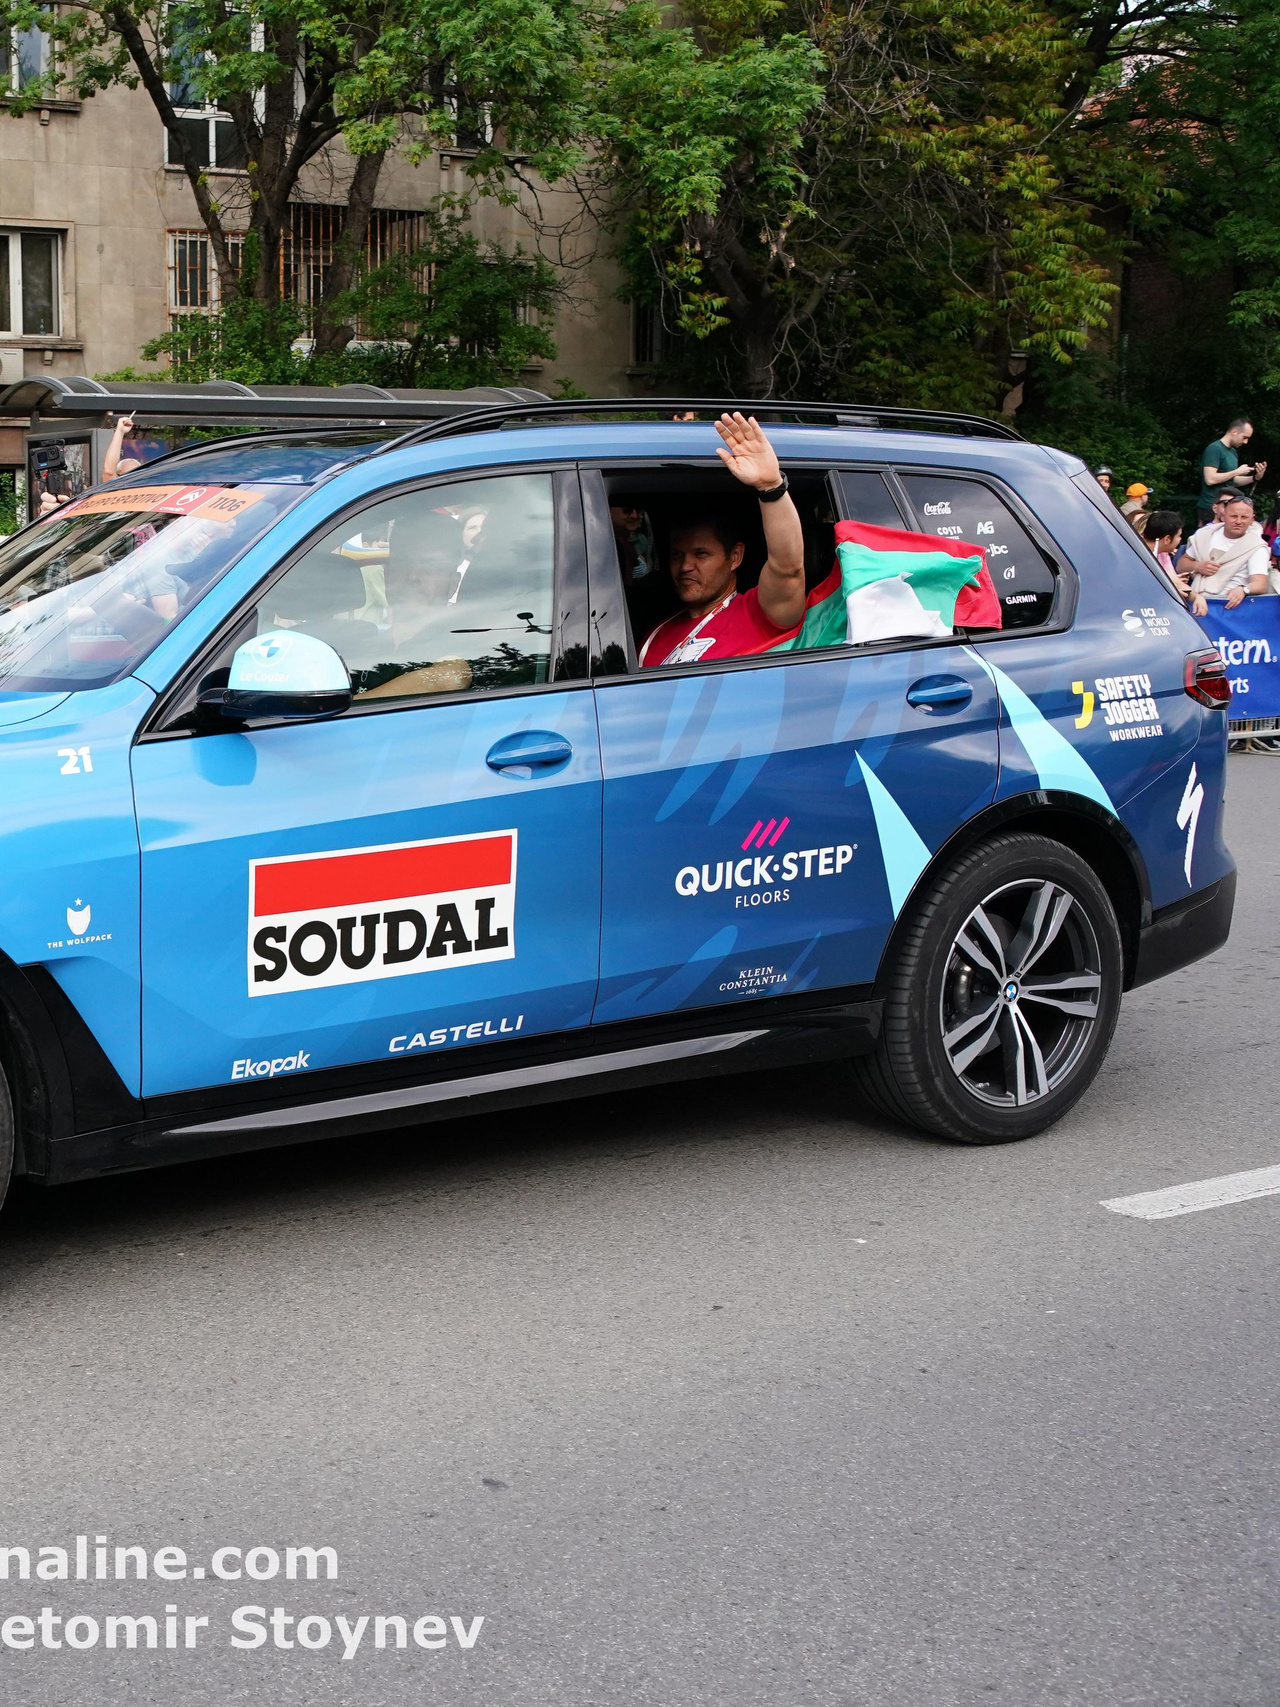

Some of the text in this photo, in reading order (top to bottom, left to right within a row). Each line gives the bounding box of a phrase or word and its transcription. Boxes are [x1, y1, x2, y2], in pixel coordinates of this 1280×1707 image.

[208, 496, 246, 512] 1106
[937, 525, 963, 536] COSTA
[976, 521, 995, 535] AG
[1005, 594, 1038, 605] GARMIN
[1141, 608, 1156, 617] UCI
[1144, 618, 1171, 627] WORLD
[1149, 627, 1171, 636] TOUR
[1094, 673, 1153, 702] SAFETY
[1100, 698, 1160, 726] JOGGER
[1108, 724, 1164, 742] WORKWEAR
[56, 745, 94, 776] 21
[735, 888, 791, 909] FLOORS
[47, 933, 113, 949] THE WOLFPACK
[252, 896, 510, 983] SOUDAL
[738, 965, 774, 980] KLEIN
[718, 973, 789, 992] CONSTANTIA
[388, 1015, 524, 1053] CASTELLI
[230, 1049, 311, 1081] Ekopak
